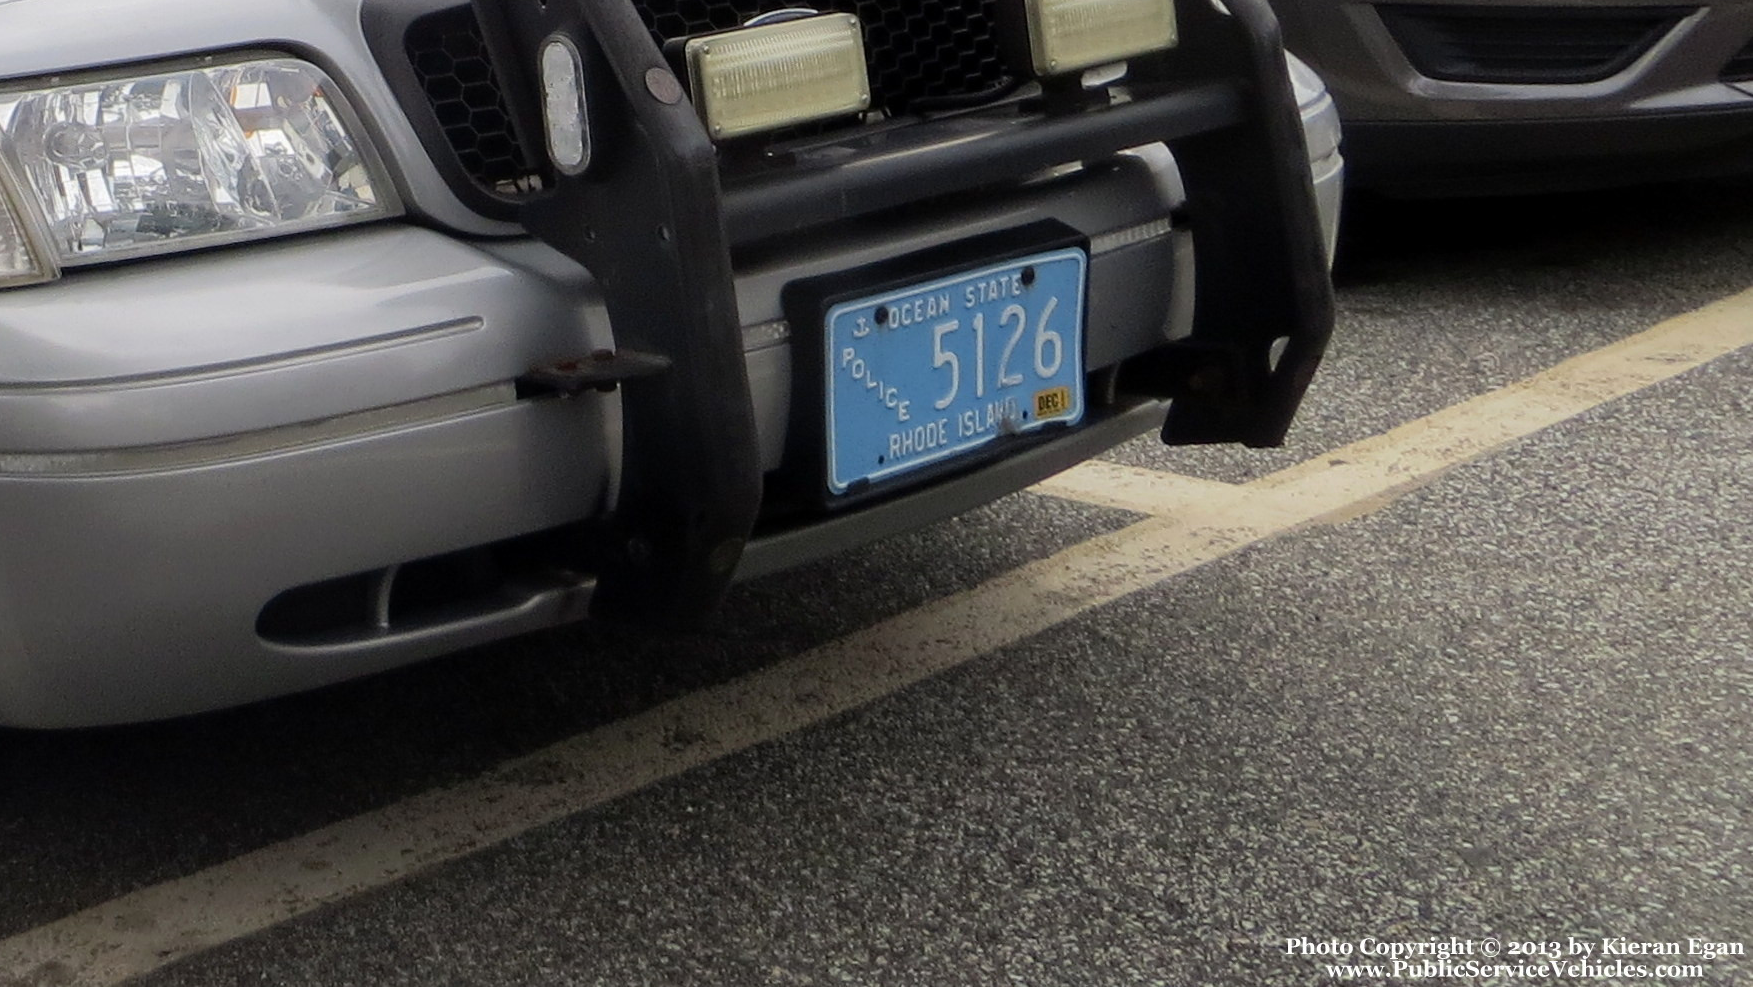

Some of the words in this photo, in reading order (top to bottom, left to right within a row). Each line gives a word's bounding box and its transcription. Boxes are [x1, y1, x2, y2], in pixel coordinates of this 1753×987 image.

[887, 294, 950, 329] OCEAN
[965, 274, 1022, 309] STATE
[842, 347, 911, 422] POLICE
[932, 296, 1063, 411] 5126
[889, 418, 949, 460] RHODE
[958, 396, 1018, 438] ISLAND
[1037, 392, 1060, 412] DEC
